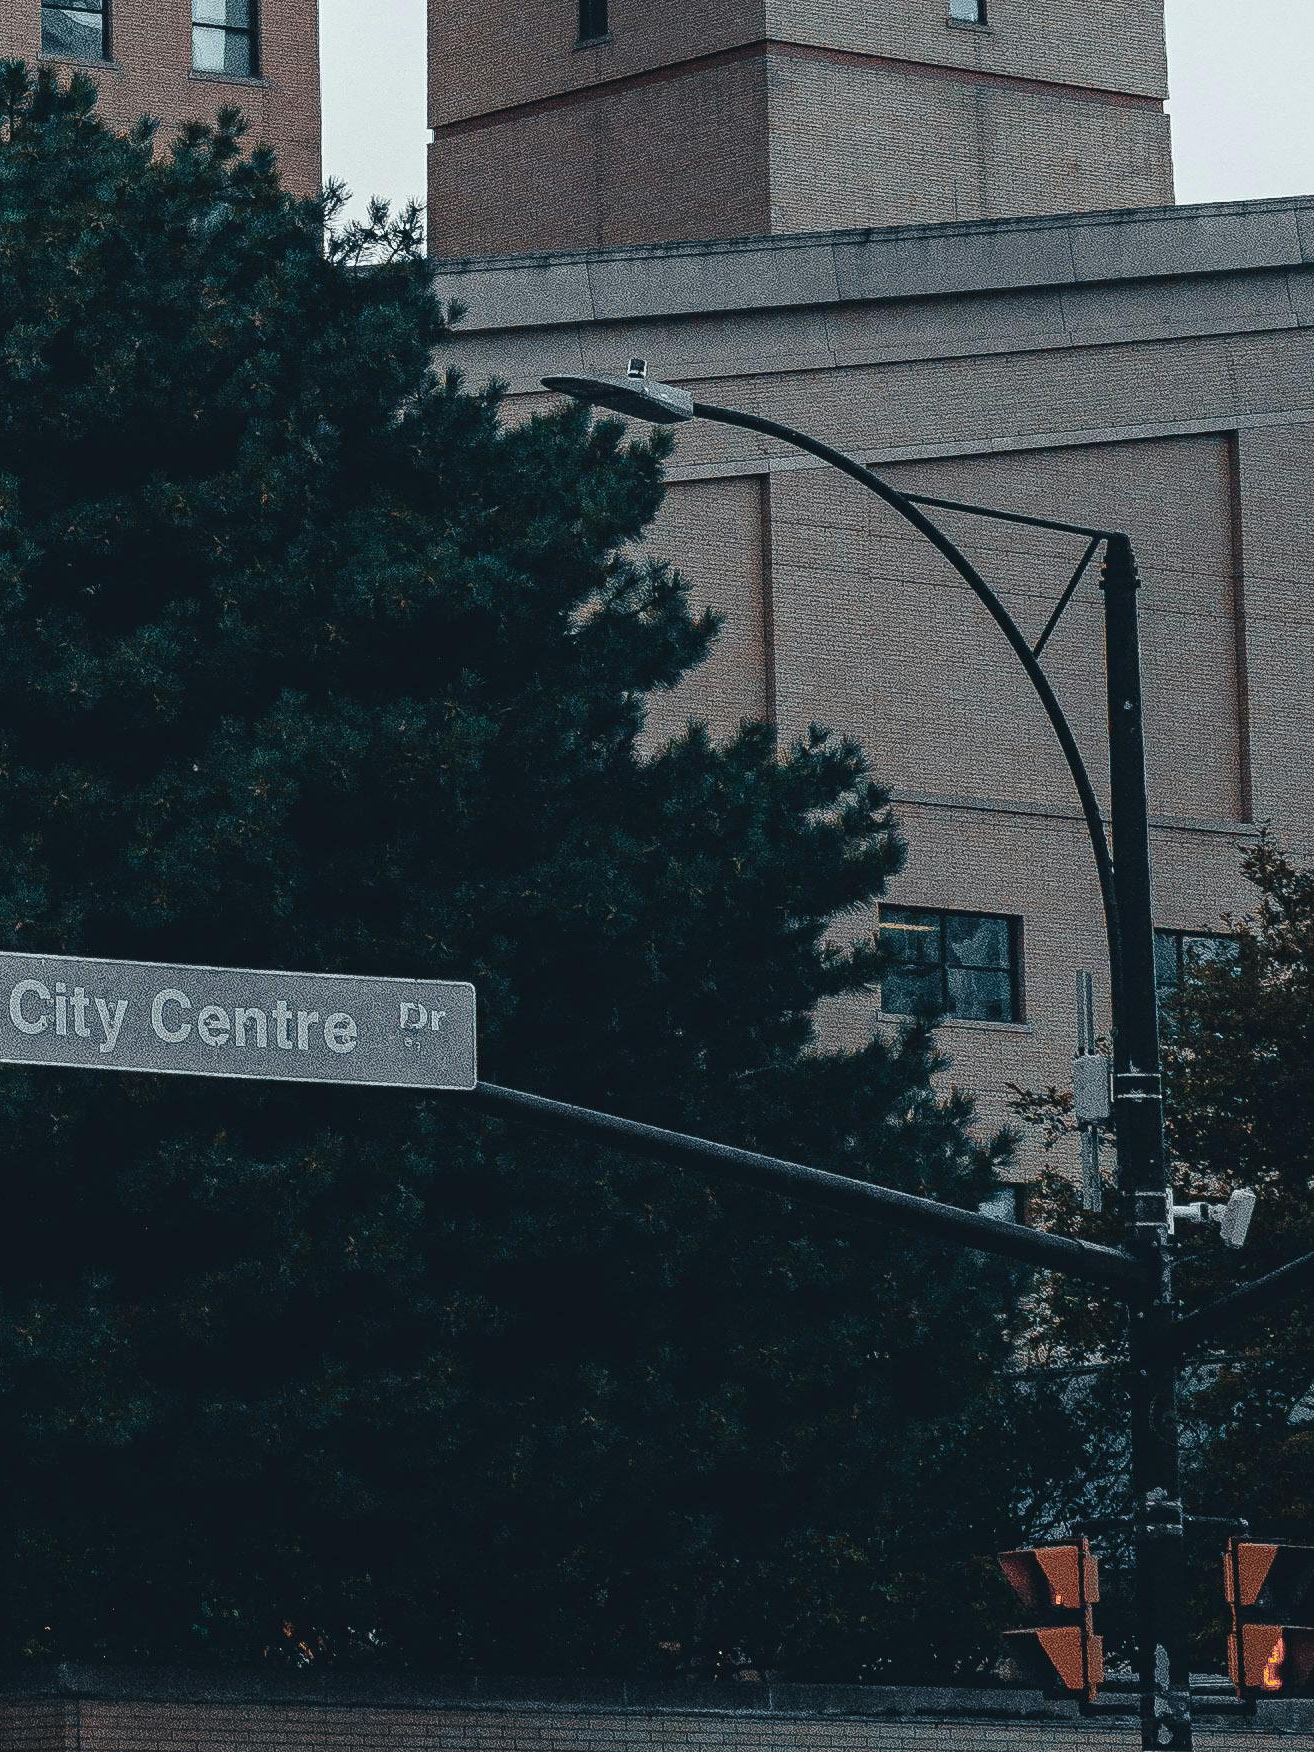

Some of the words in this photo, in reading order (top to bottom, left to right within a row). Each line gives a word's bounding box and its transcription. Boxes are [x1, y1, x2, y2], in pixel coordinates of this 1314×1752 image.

[9, 979, 128, 1053] City
[151, 987, 358, 1054] Centre
[399, 1001, 446, 1031] Dr
